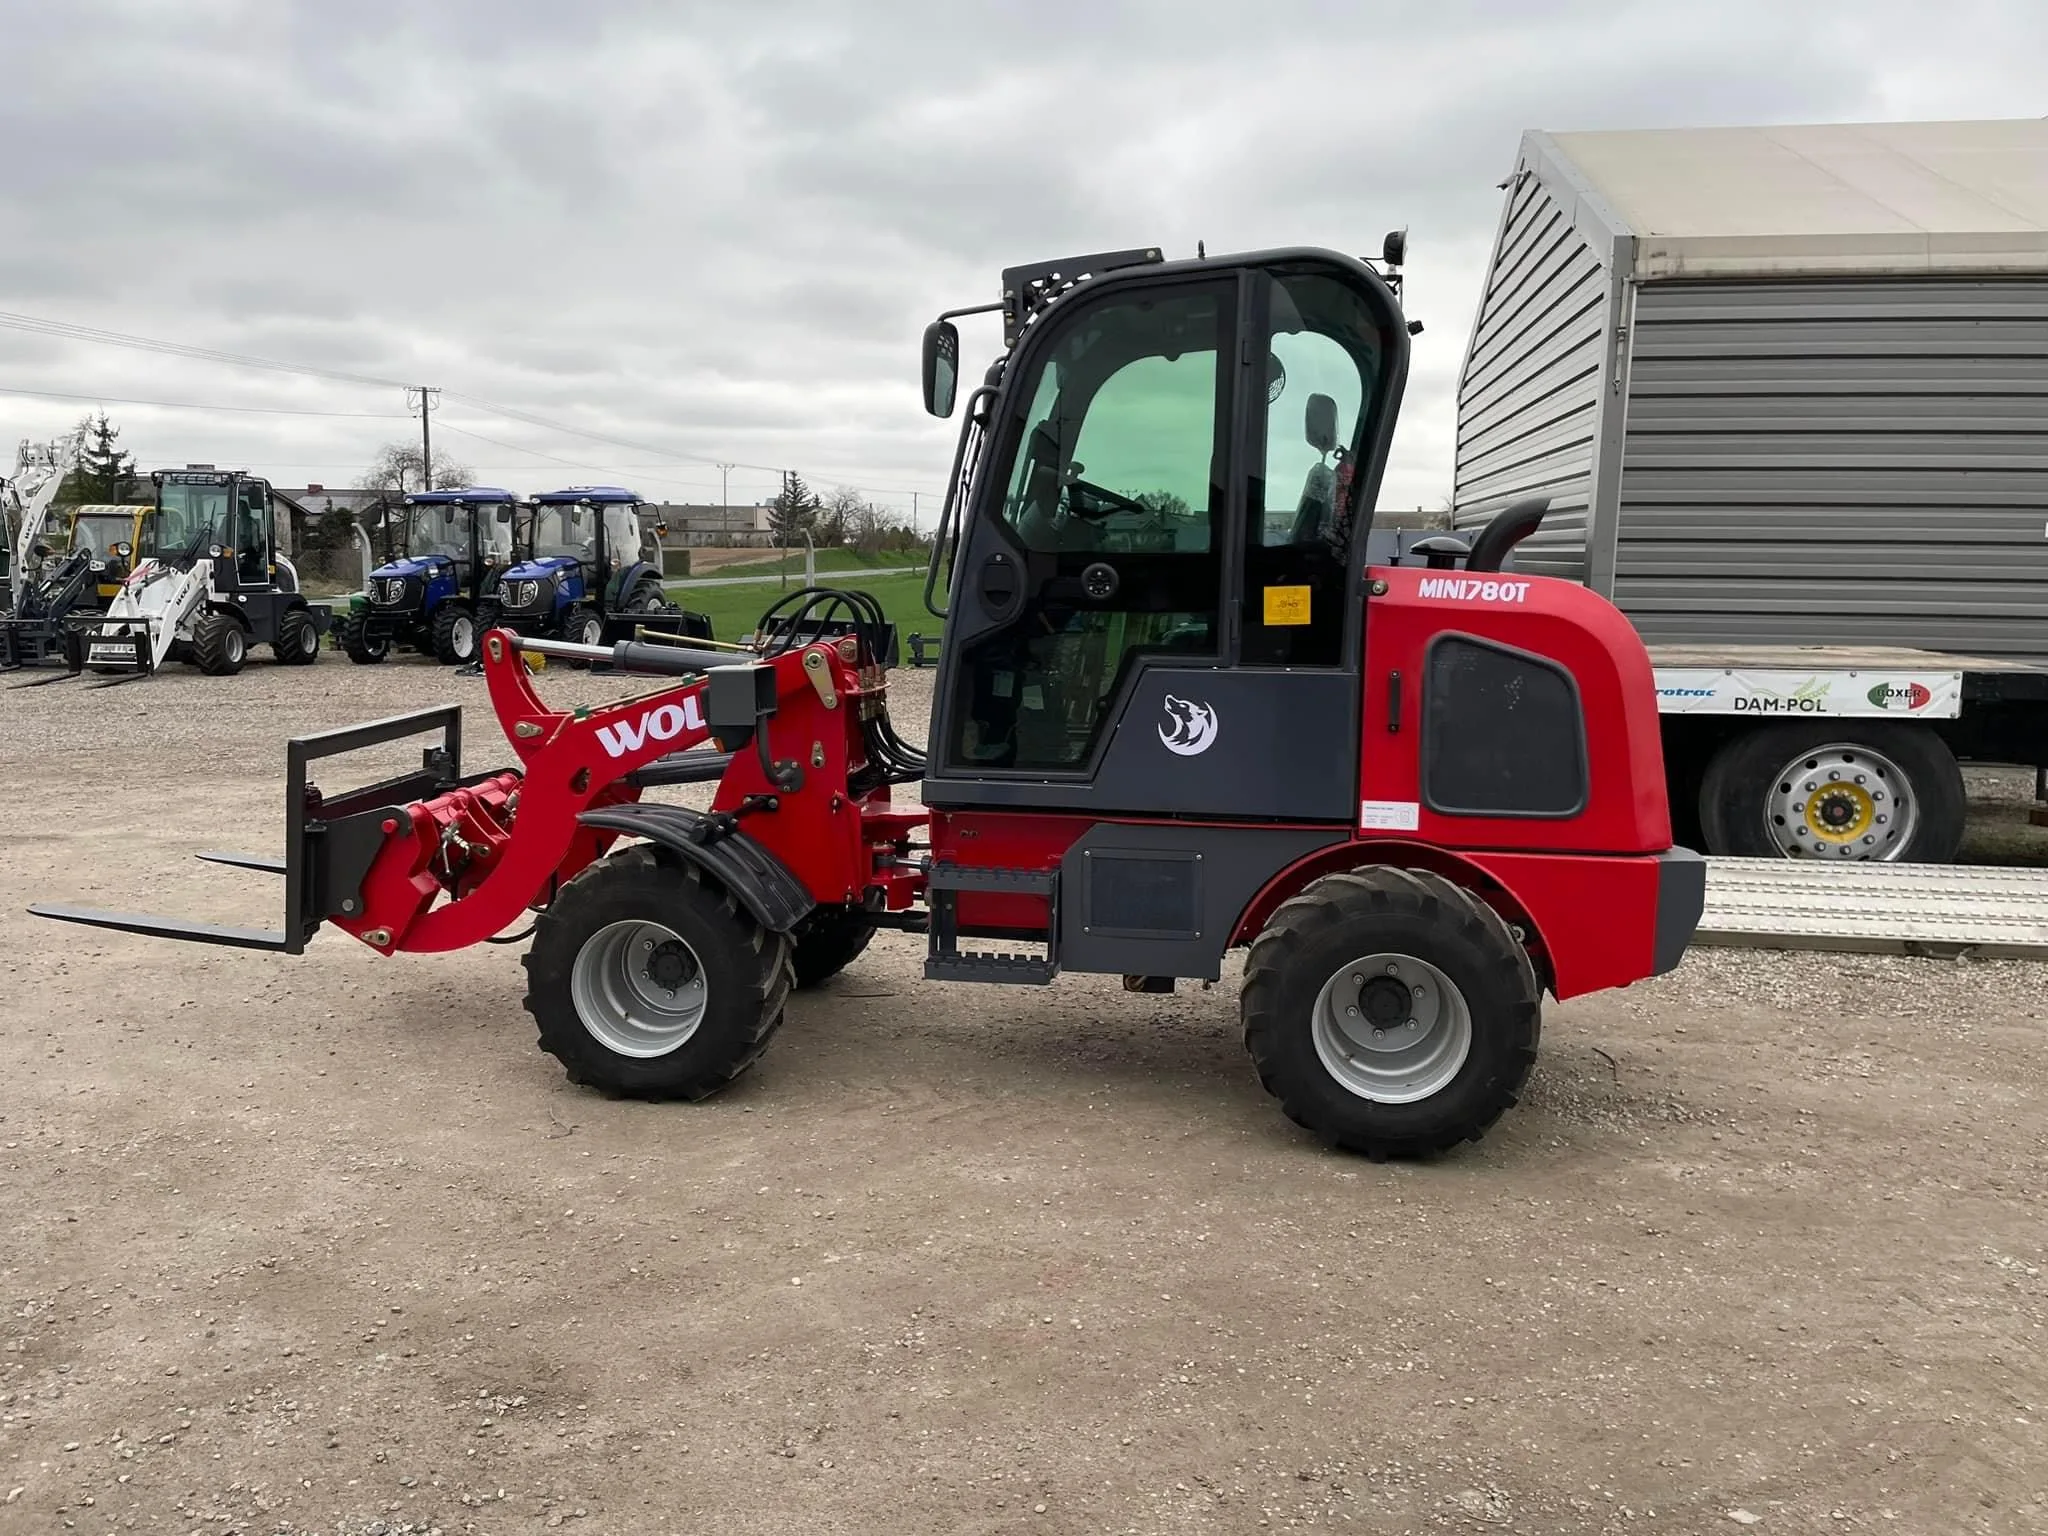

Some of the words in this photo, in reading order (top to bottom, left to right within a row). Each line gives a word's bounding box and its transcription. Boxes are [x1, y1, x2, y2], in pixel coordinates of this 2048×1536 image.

[1418, 577, 1530, 603] MINI780T
[1877, 688, 1921, 698] BOXER
[1734, 697, 1827, 712] DAM-POL
